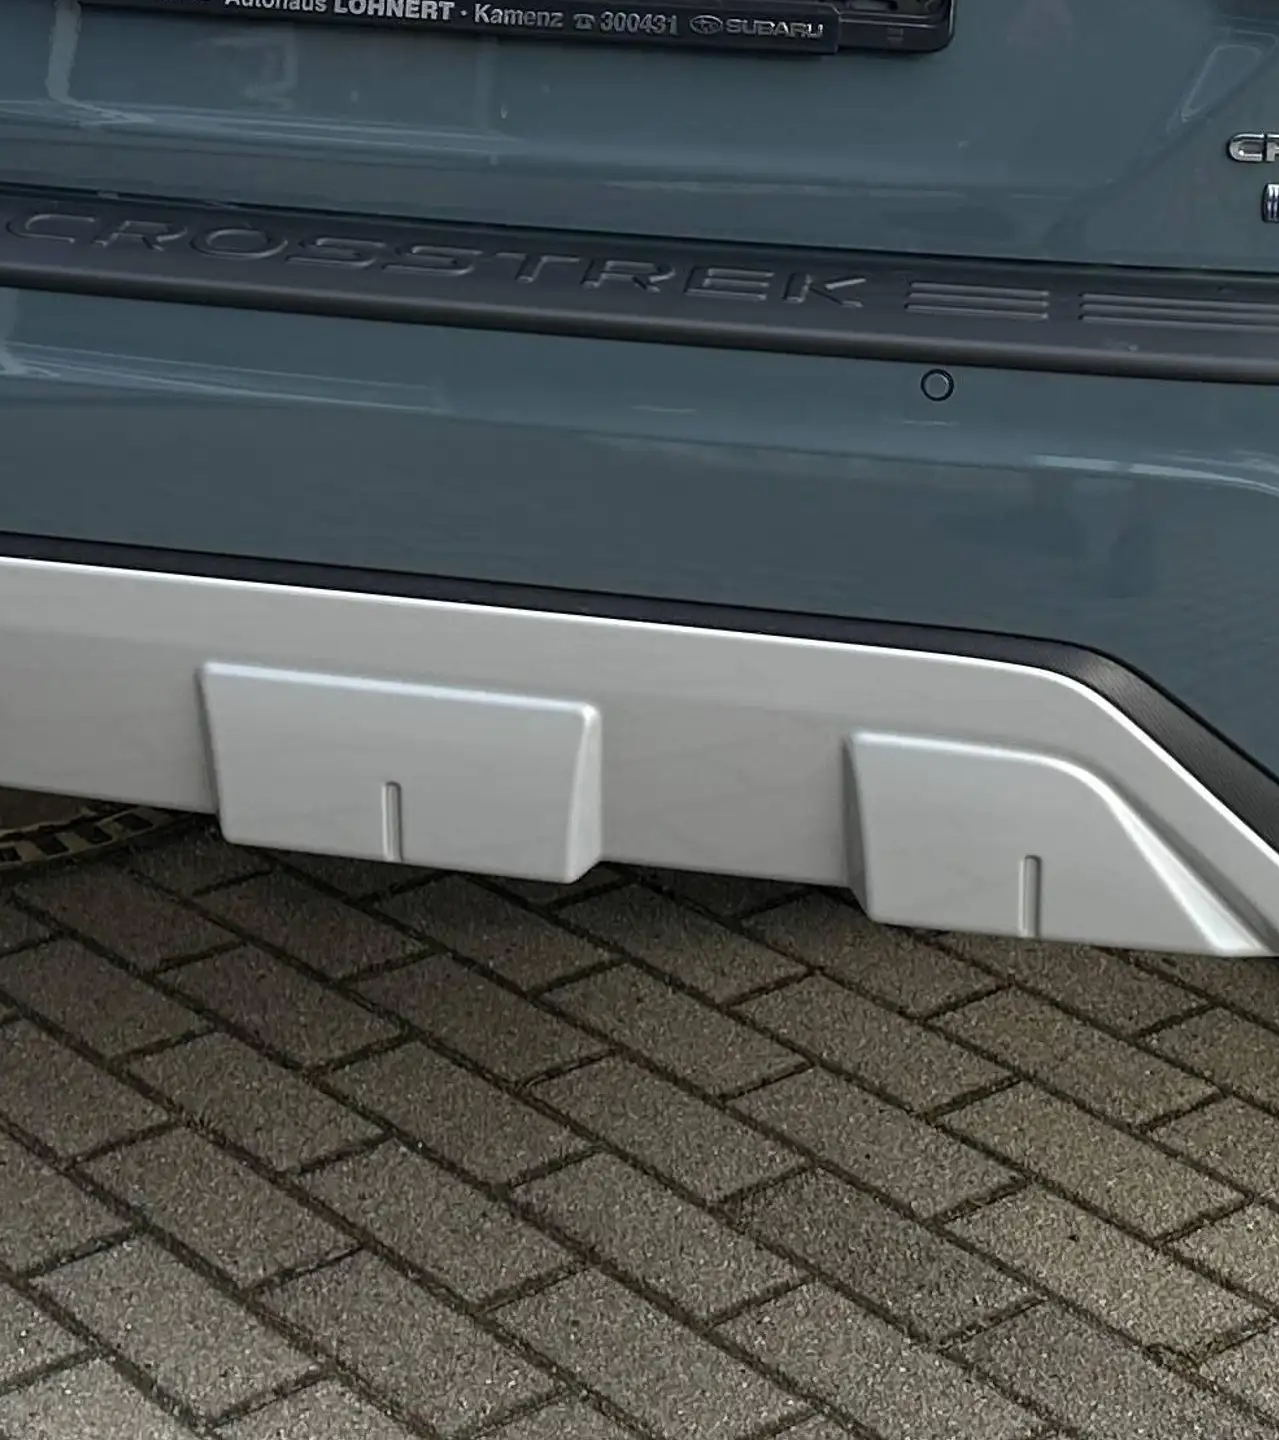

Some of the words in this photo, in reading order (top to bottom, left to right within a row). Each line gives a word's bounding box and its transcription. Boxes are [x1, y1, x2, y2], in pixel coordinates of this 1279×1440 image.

[473, 2, 564, 28] Kamenz
[599, 10, 680, 36] 300431
[724, 17, 824, 39] SUBARU
[5, 212, 868, 308] CROSSTREK
